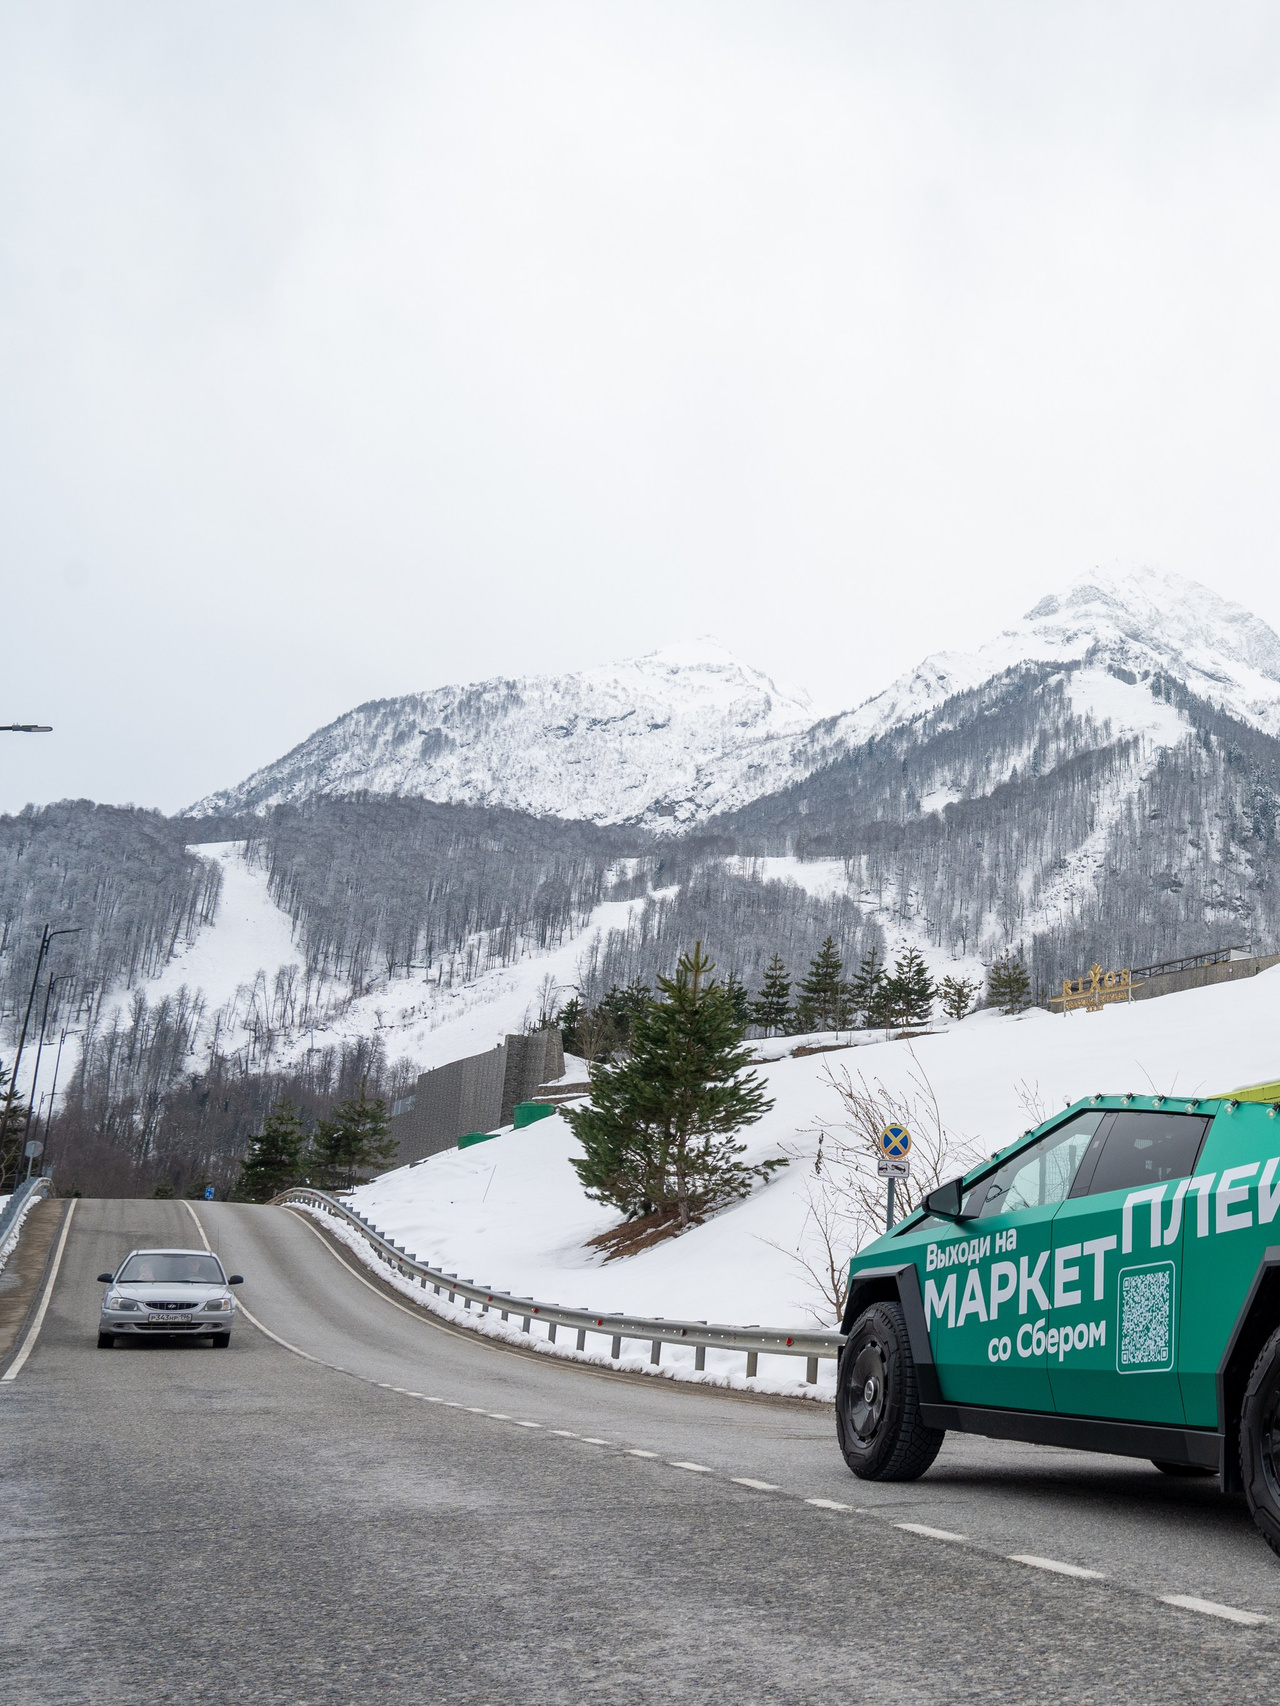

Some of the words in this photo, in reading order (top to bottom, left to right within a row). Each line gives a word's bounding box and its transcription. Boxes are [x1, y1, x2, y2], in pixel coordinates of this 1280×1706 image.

[1062, 963, 1130, 997] RIXOS
[926, 1235, 991, 1272] Выходи
[995, 1228, 1018, 1254] на
[924, 1234, 1117, 1332] МАРКЕТ
[988, 1336, 1012, 1363] со
[1017, 1318, 1106, 1362] Сбером
